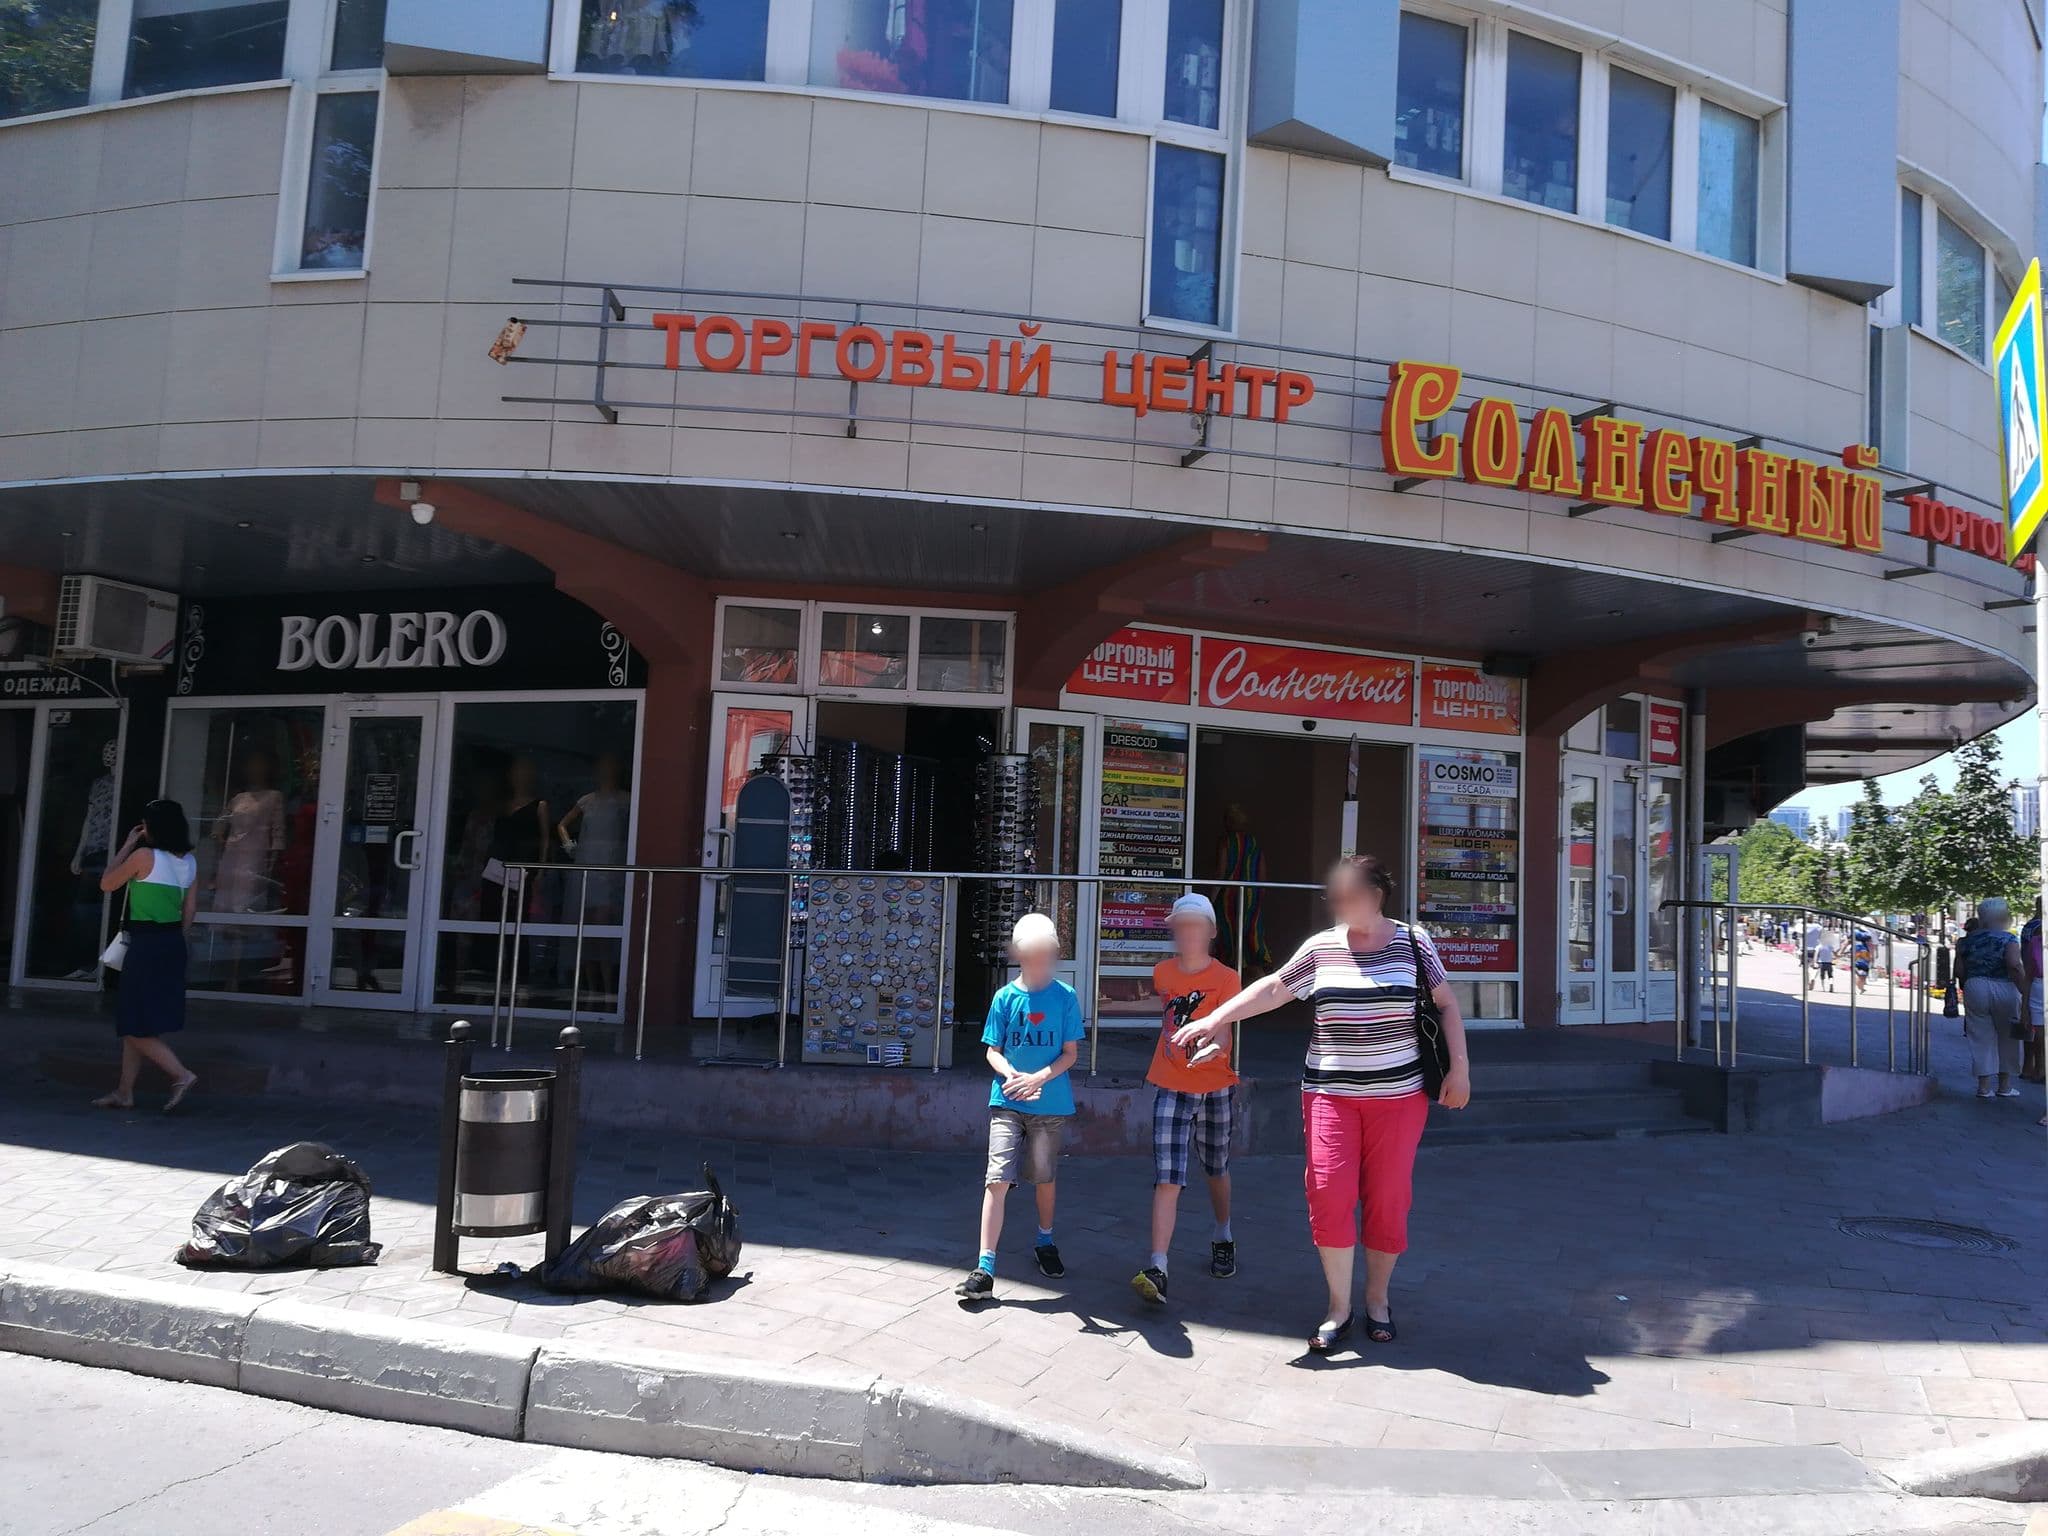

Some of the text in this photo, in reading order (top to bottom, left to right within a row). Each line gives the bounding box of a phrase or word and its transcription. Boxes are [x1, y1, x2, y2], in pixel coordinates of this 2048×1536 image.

[653, 312, 1316, 423] ТОРГОВЫЙ ЦЕНТР
[1382, 359, 1884, 553] Солнечный
[276, 609, 507, 671] BOLERO
[1086, 642, 1175, 669] ОРГОВЫЙ
[1083, 663, 1175, 687] ЦЕНТР
[1207, 647, 1407, 706] Солнечный
[3, 676, 82, 696] ОДЕЖДА
[1433, 700, 1507, 720] ЦЕНТР
[1434, 764, 1495, 782] COSMO
[1457, 784, 1492, 795] ESCADA
[1120, 809, 1151, 817] ЖЕНСКАЯ
[1153, 811, 1180, 819] ОДЕЖДА
[1154, 835, 1181, 843] ОДЕЖДА
[1453, 838, 1491, 849] LIDER
[1131, 869, 1165, 877] ОДЕЖДА
[1486, 873, 1509, 881] МОДА
[1100, 917, 1144, 926] STYLE
[1470, 943, 1500, 952] РЕМОНТ
[1018, 1010, 1025, 1027] I
[1011, 1030, 1056, 1048] BALI
